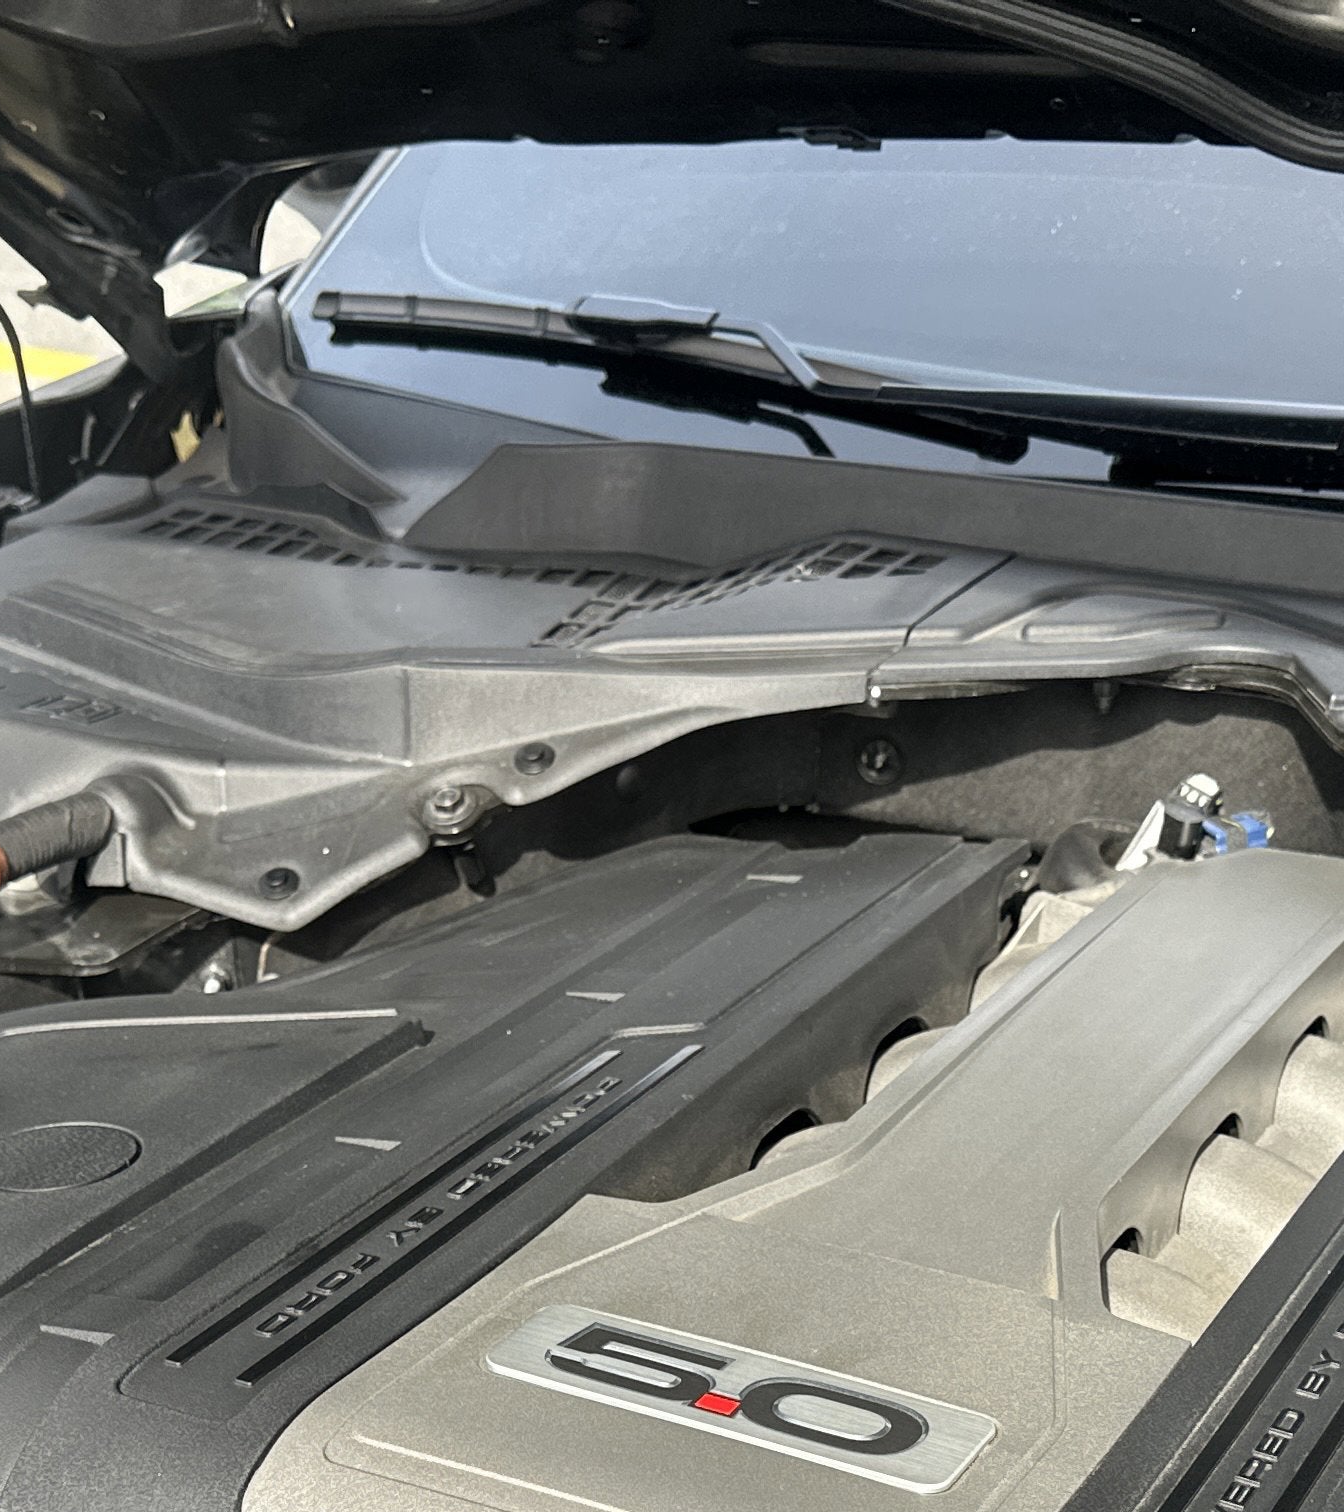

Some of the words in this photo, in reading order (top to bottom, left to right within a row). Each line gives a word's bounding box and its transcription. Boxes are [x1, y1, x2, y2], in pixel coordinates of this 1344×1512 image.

[386, 1205, 444, 1246] BY
[256, 1252, 380, 1338] FORD
[544, 1322, 930, 1457] 5.0
[1295, 1348, 1342, 1400] BY
